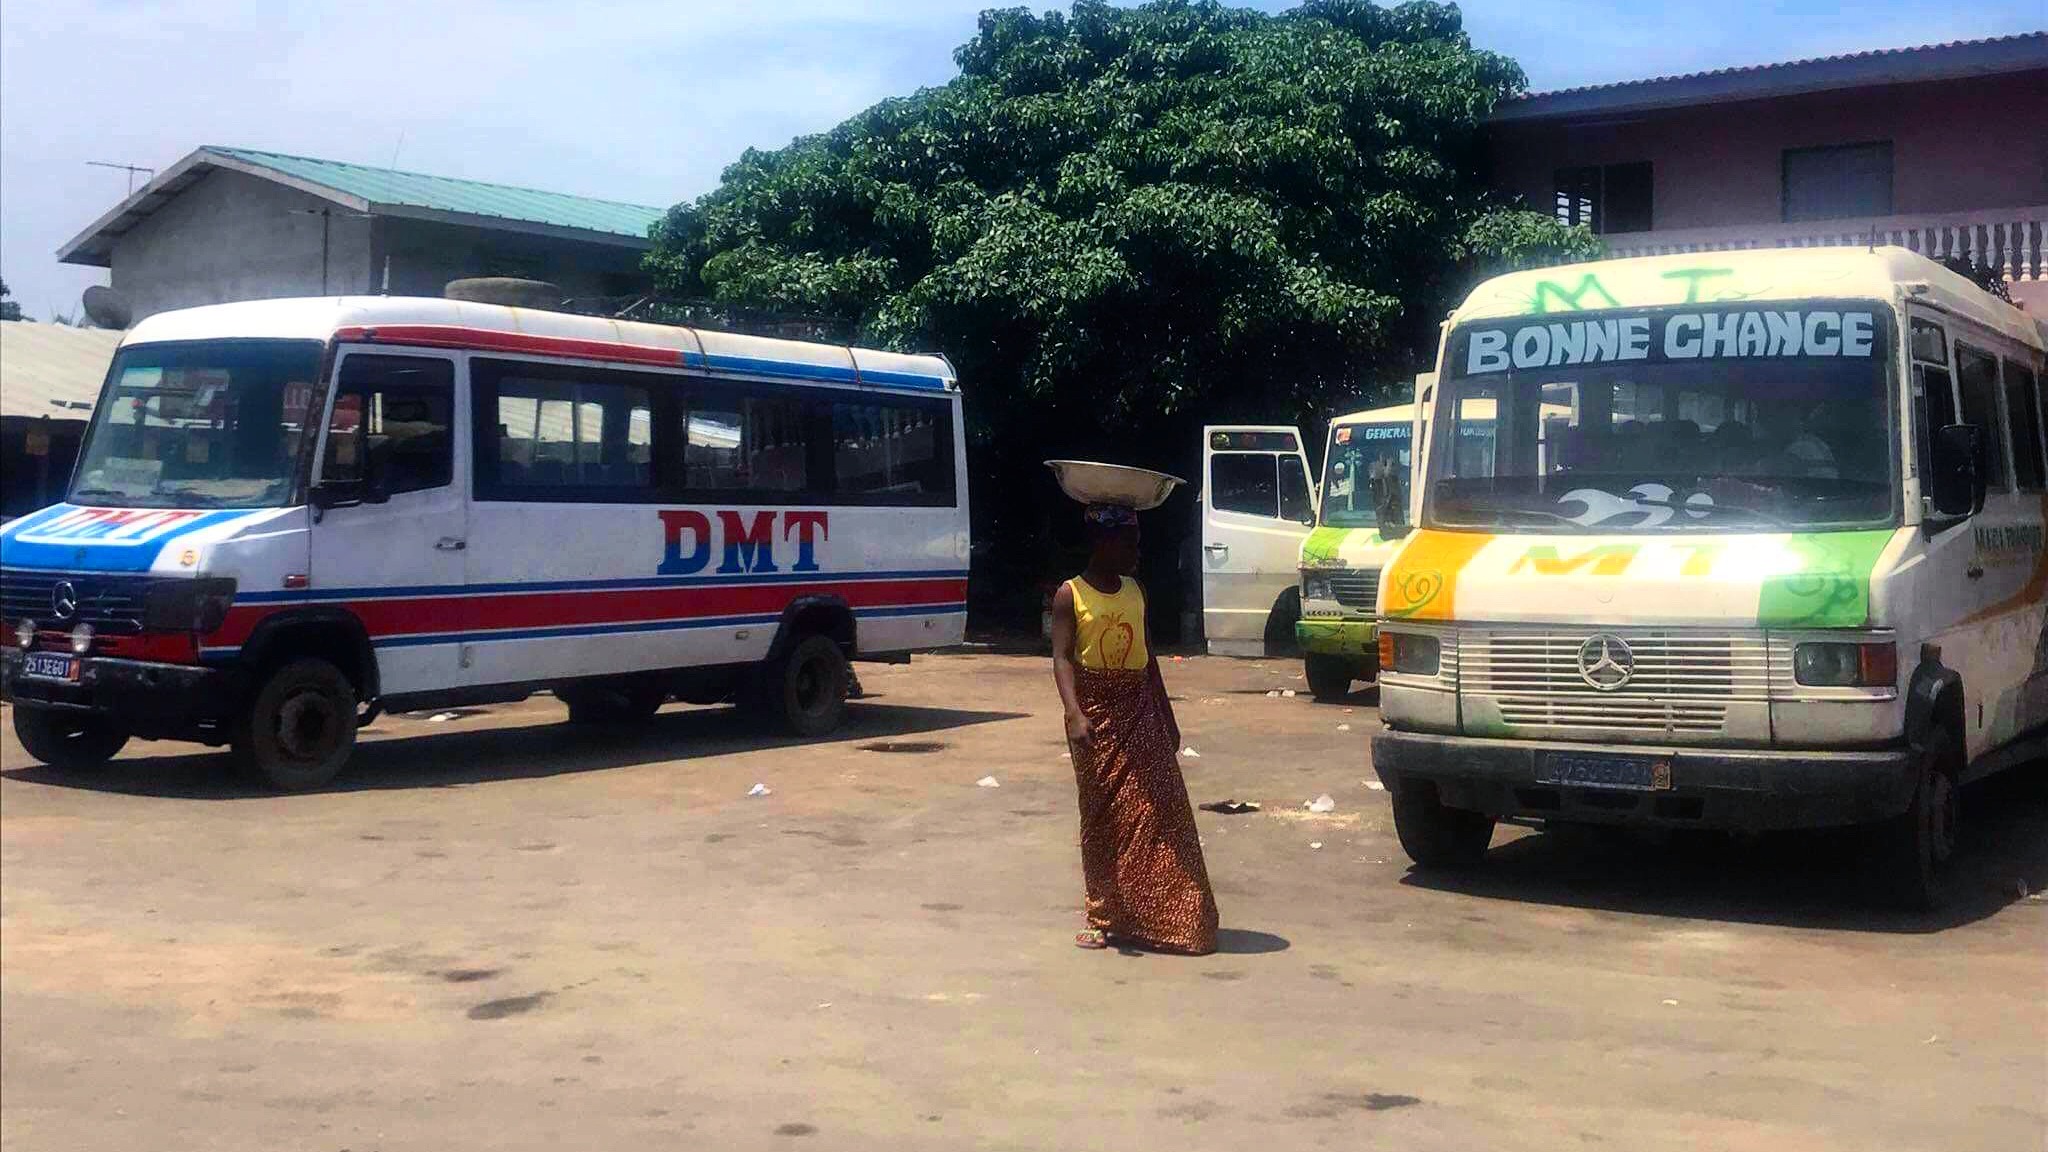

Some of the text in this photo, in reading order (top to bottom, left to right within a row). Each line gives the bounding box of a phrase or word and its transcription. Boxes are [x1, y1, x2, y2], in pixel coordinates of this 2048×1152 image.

[1467, 311, 1873, 375] BONNE CHANCE
[25, 508, 205, 540] DMT
[657, 510, 828, 575] DMT
